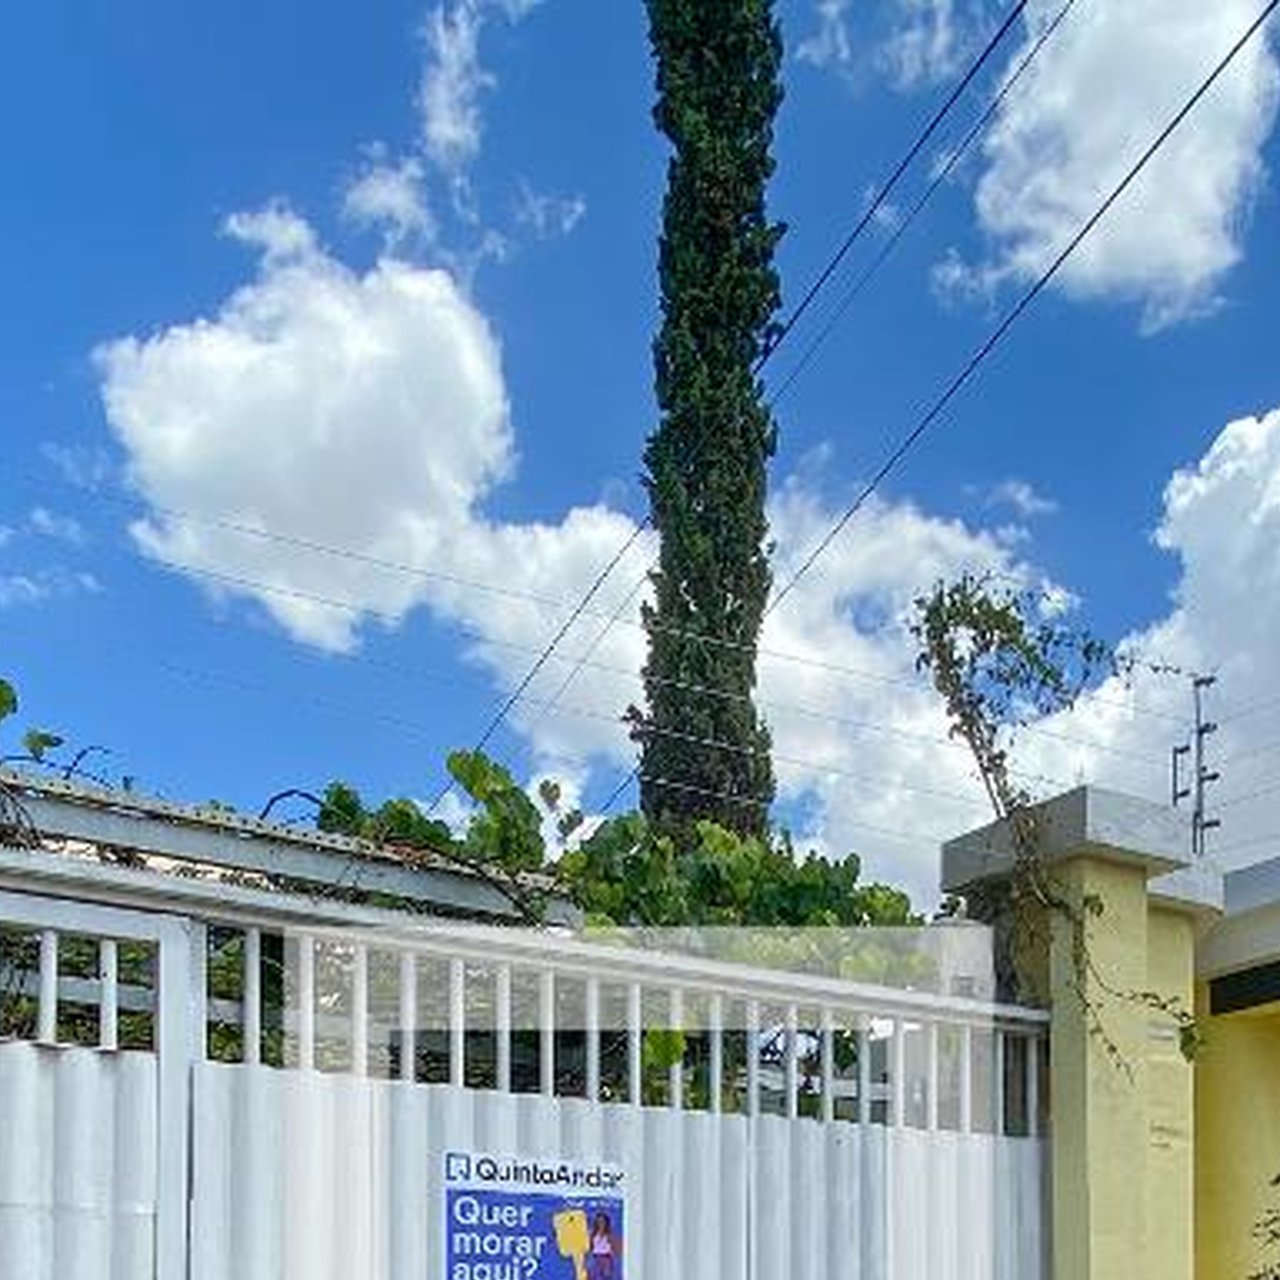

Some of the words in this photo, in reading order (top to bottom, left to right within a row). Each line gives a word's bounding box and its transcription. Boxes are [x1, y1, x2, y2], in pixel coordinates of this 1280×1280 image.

[476, 1158, 624, 1189] QuintoAndar
[453, 1196, 533, 1227] Quer
[453, 1232, 547, 1257] morar
